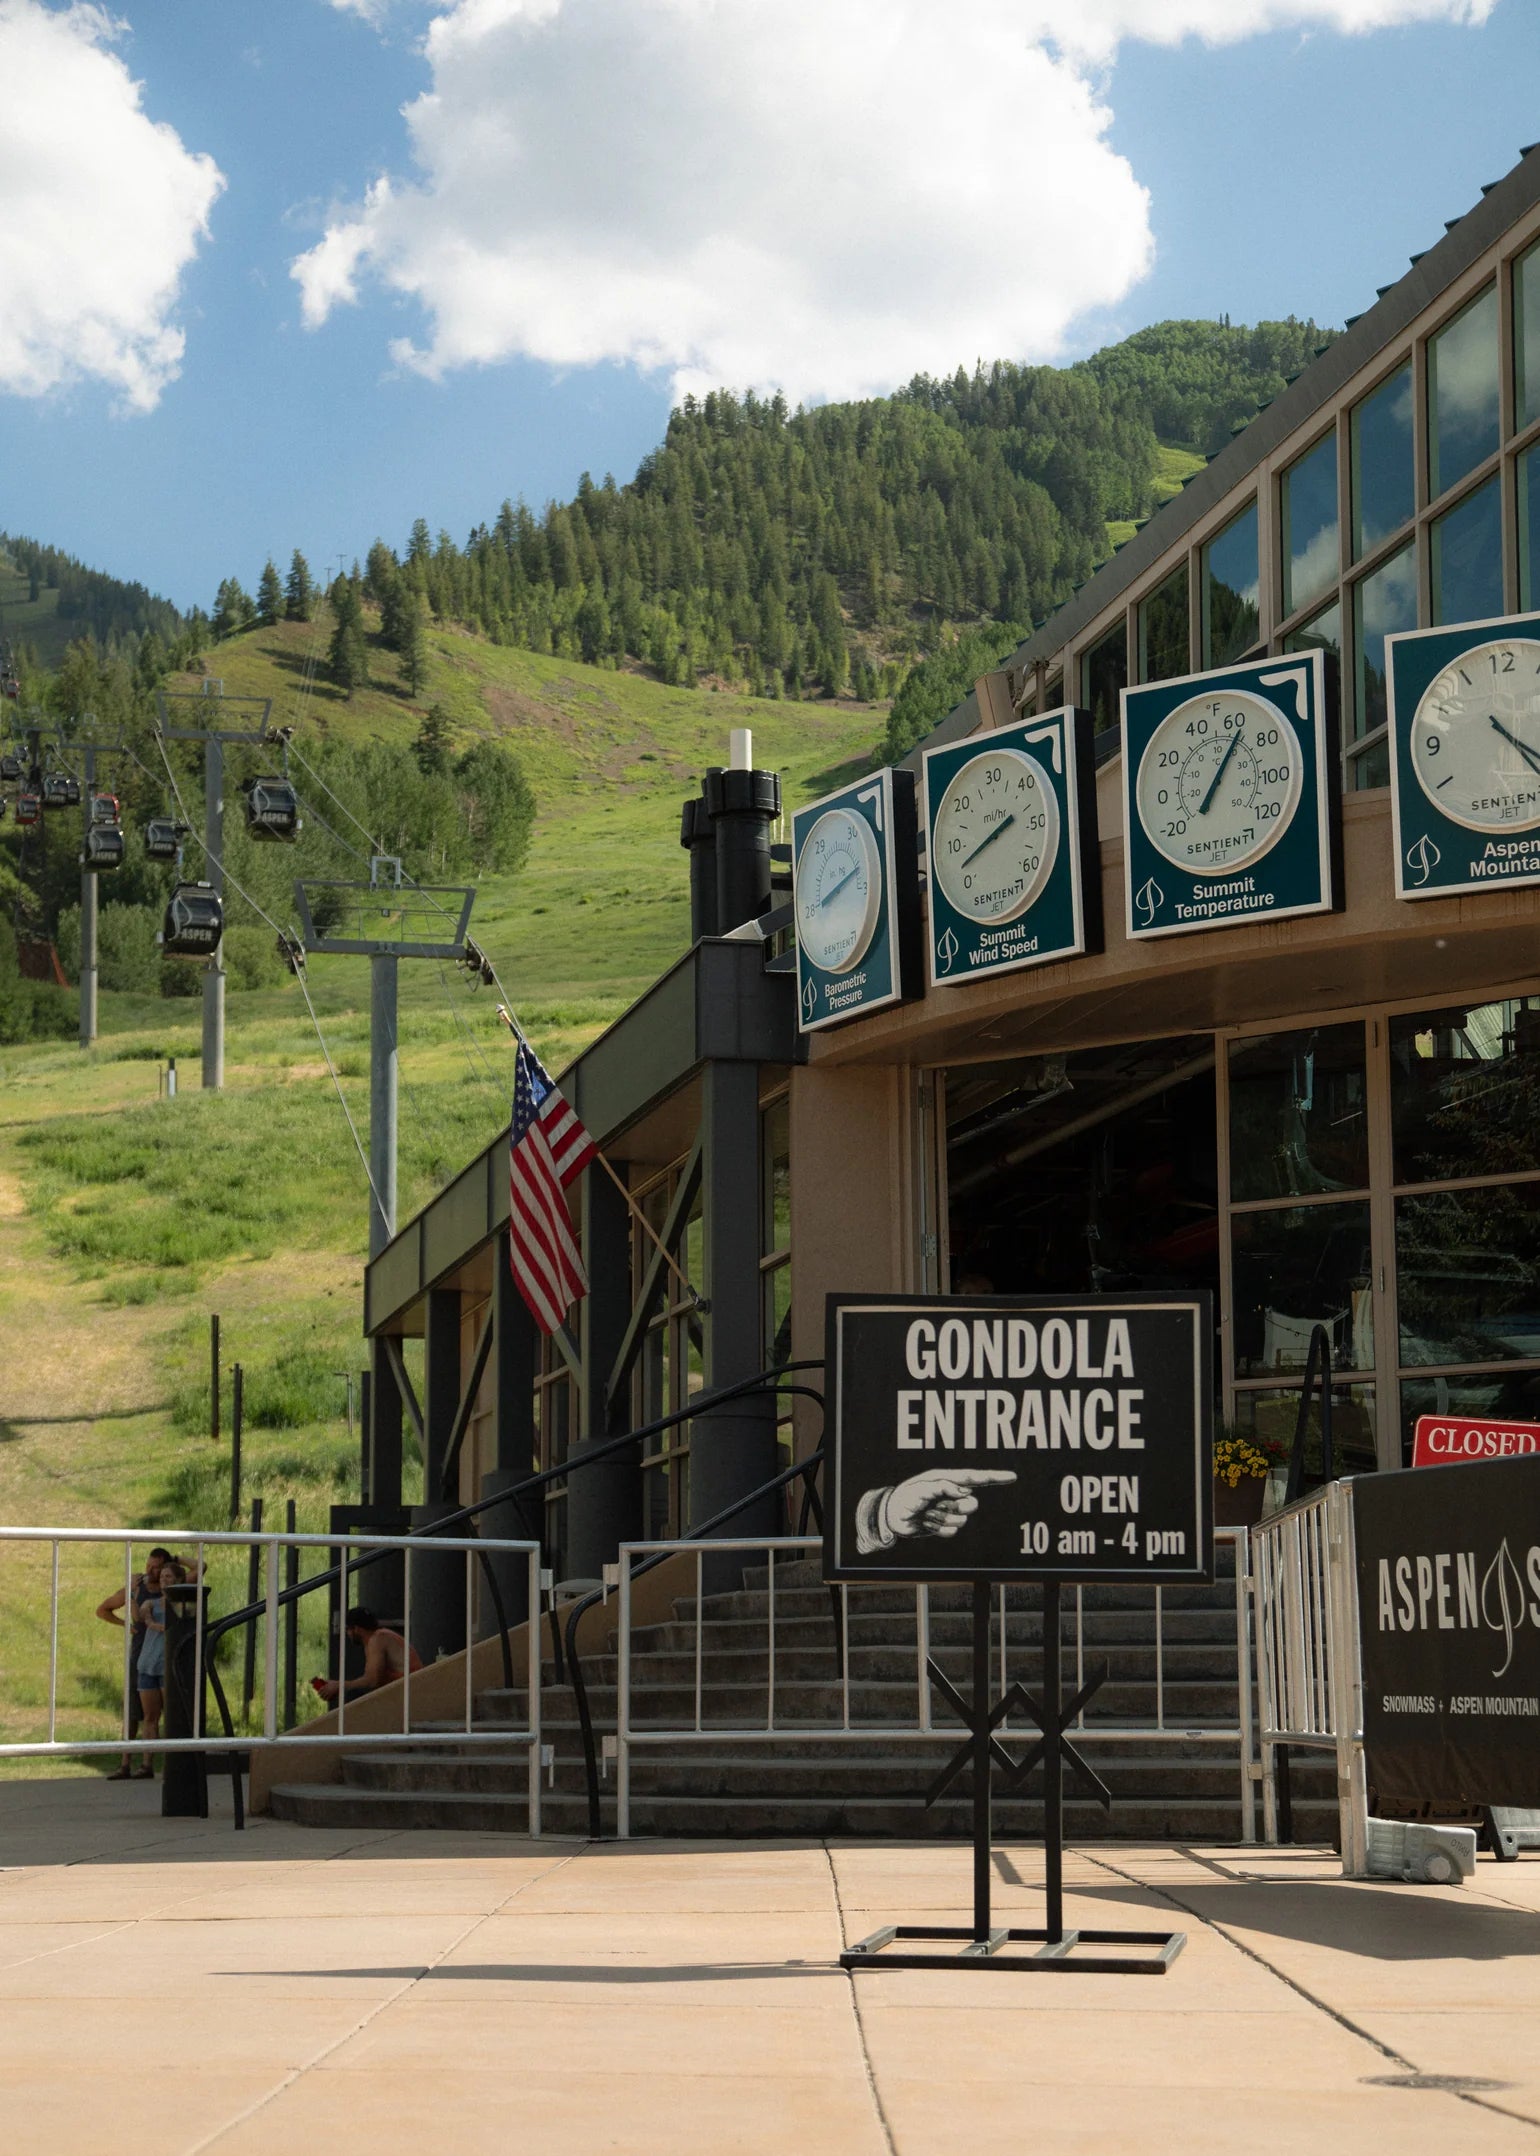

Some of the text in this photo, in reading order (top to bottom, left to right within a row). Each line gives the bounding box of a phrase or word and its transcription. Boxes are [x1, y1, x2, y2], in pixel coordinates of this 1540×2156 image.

[1489, 651, 1515, 675] 12
[1186, 720, 1208, 736] 40
[1224, 712, 1245, 730] 60
[1257, 730, 1278, 747] 80
[1426, 735, 1440, 756] 9
[1158, 750, 1179, 767] 20
[985, 768, 1001, 785] 30
[1018, 774, 1035, 791] 40
[1262, 766, 1290, 784] 100
[954, 796, 970, 812] 20
[1158, 790, 1168, 804] 0
[1255, 802, 1281, 820] 120
[1499, 806, 1520, 819] JET
[1030, 813, 1046, 831] 50
[1160, 820, 1187, 837] -20
[814, 839, 826, 855] 29
[948, 838, 961, 854] 10
[1187, 835, 1250, 855] SENTIENT
[1484, 839, 1540, 859] Aspen
[1023, 856, 1039, 873] 60
[1210, 850, 1228, 863] JET
[963, 875, 972, 889] 0
[1192, 877, 1256, 900] Summit
[974, 885, 1020, 906] SENTIENT
[804, 904, 816, 919] 28
[990, 901, 1004, 913] JET
[1175, 893, 1275, 919] Temperature
[980, 924, 1026, 947] Summit
[824, 938, 855, 956] SENTIENT
[969, 936, 1038, 965] Wind Speed
[825, 972, 867, 997] Barometric
[829, 989, 862, 1010] Pressure
[905, 1318, 1134, 1380] GONDOLA
[897, 1388, 1145, 1450] ENTRANCE
[1428, 1427, 1537, 1457] CLOSED
[1060, 1475, 1139, 1514] OPEN
[1019, 1521, 1049, 1555] 10
[1057, 1531, 1096, 1555] am
[1121, 1521, 1139, 1555] 4
[1146, 1530, 1186, 1561] pm
[1379, 1552, 1479, 1632] ASPEN
[1383, 1695, 1539, 1716] SNOWMASS ASPEN MOUNTAIN
